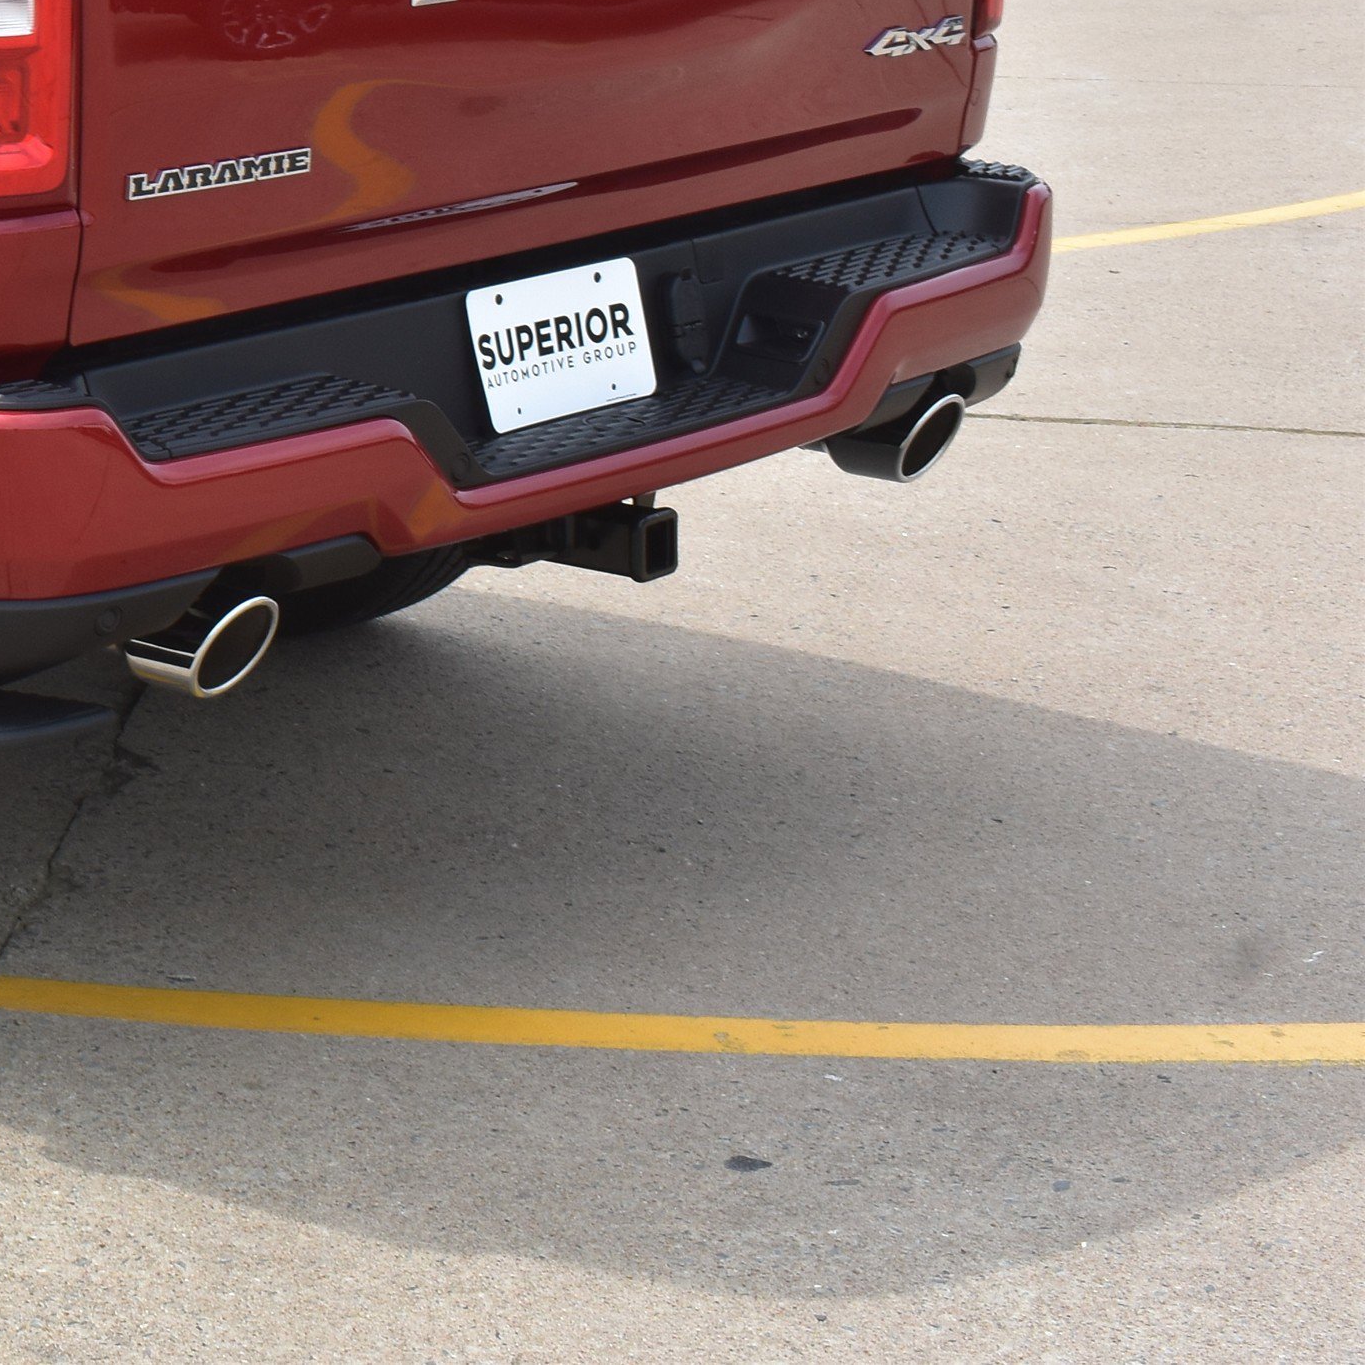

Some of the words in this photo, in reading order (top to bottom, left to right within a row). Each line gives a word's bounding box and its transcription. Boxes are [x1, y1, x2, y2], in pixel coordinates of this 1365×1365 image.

[126, 148, 312, 201] LARAMIE
[478, 303, 634, 370] SUPERIOR
[487, 355, 575, 389] AUTOMOTIVE
[583, 341, 637, 364] GROUP
